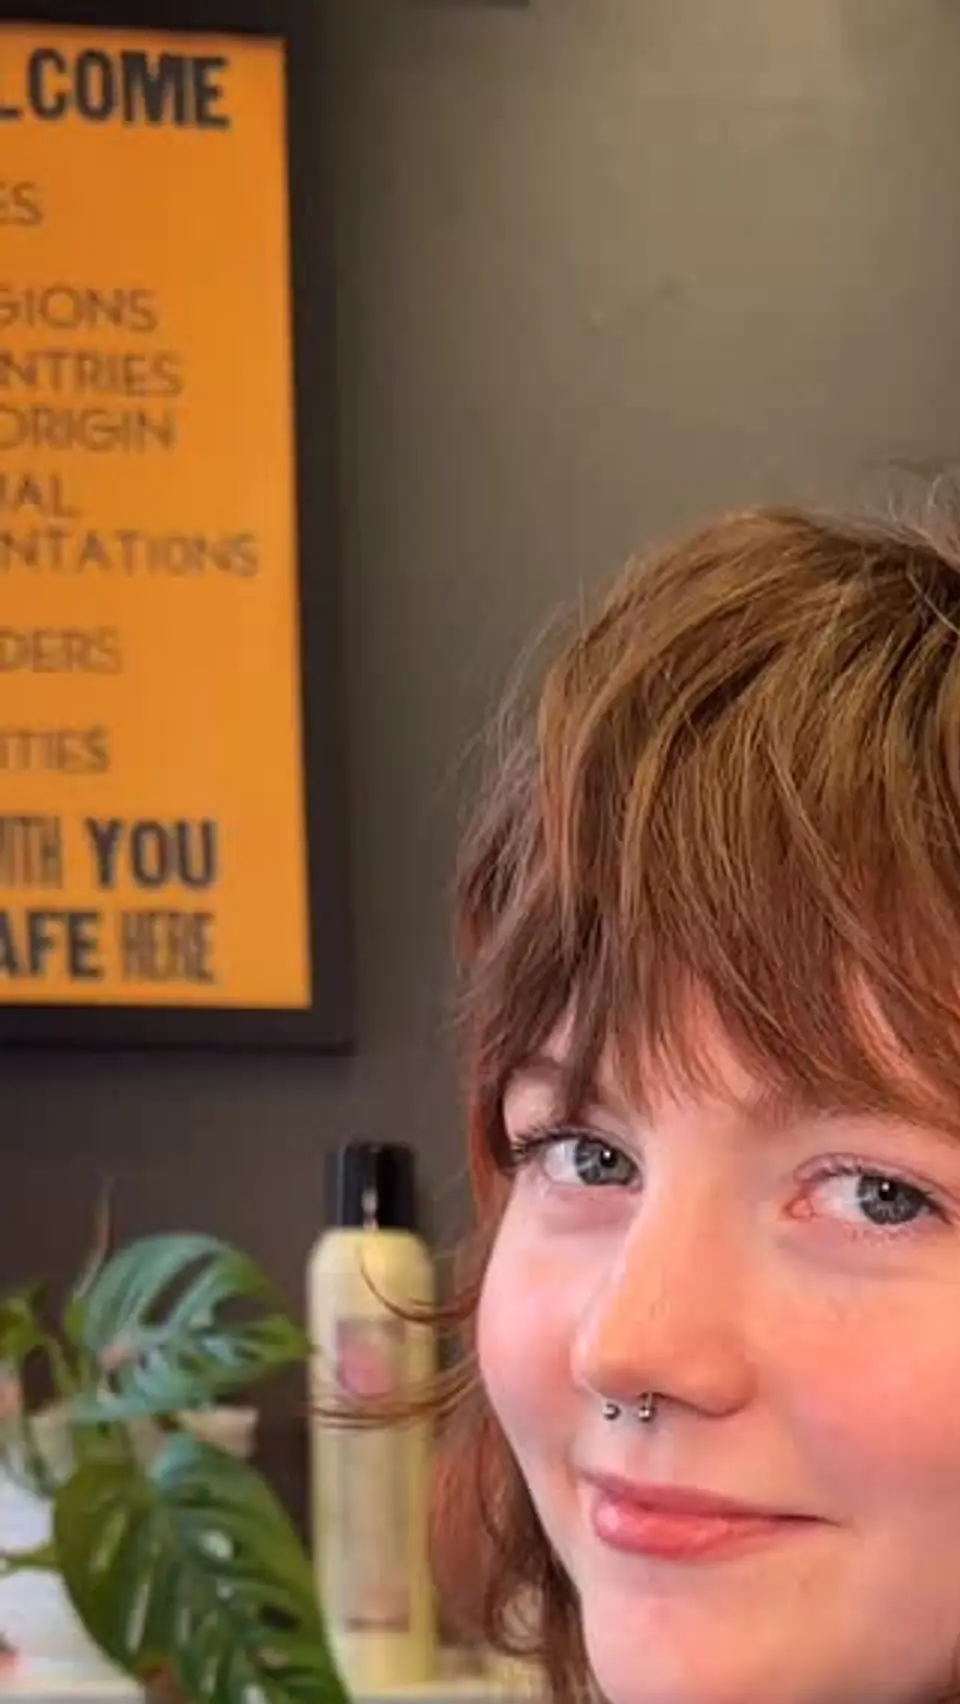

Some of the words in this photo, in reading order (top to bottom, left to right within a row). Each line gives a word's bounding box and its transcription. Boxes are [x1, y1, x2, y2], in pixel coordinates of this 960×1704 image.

[0, 47, 230, 129] COME
[0, 470, 82, 519] AL
[0, 815, 62, 890] ITH
[85, 815, 217, 890] YOU
[119, 909, 216, 986] HERE
